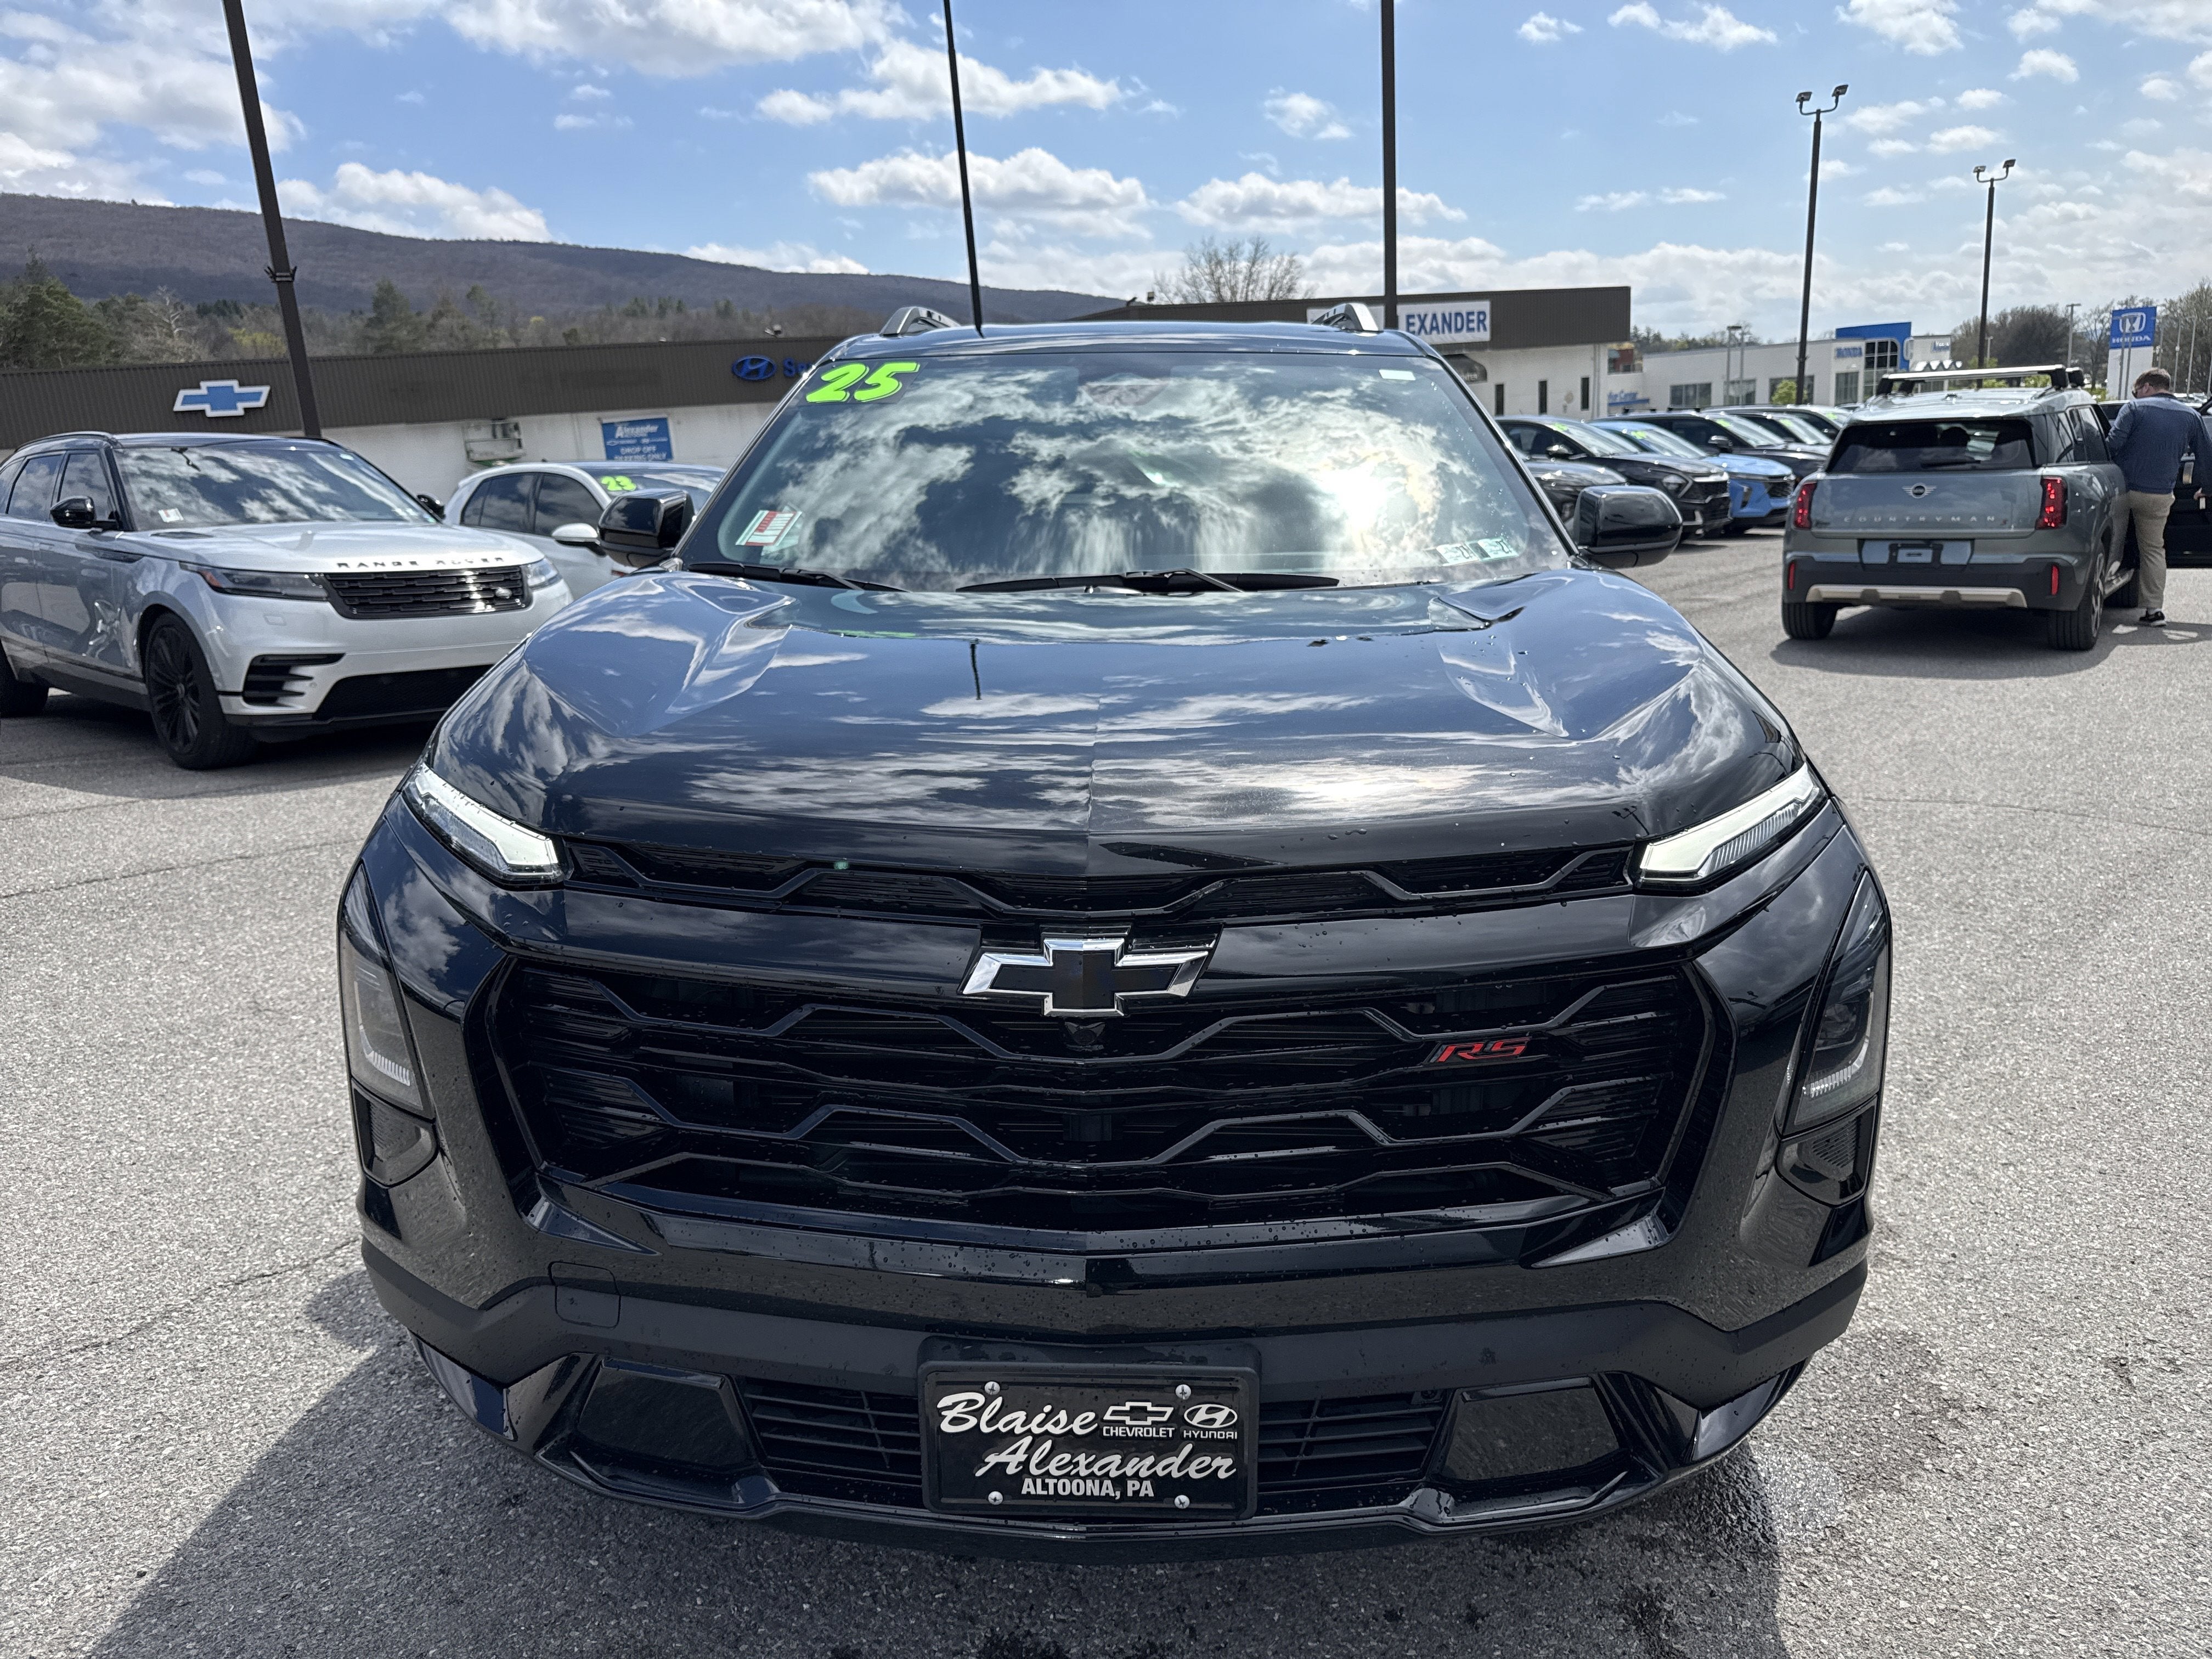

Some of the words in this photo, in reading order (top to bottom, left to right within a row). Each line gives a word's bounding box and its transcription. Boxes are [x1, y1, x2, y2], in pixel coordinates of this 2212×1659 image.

[1406, 311, 1487, 336] EXANDER
[2112, 335, 2151, 343] HONDA
[806, 363, 921, 403] 25
[620, 446, 641, 455] DROP
[642, 444, 657, 454] OFF
[601, 476, 637, 492] 23
[1433, 1036, 1532, 1063] RS
[936, 1392, 1099, 1435] Blaise
[1103, 1426, 1175, 1438] CHEVROLET
[1183, 1429, 1238, 1440] HYUNDAI
[975, 1436, 1237, 1480] Alexander
[1021, 1478, 1121, 1500] ALTOONA,
[1127, 1480, 1154, 1498] PA
